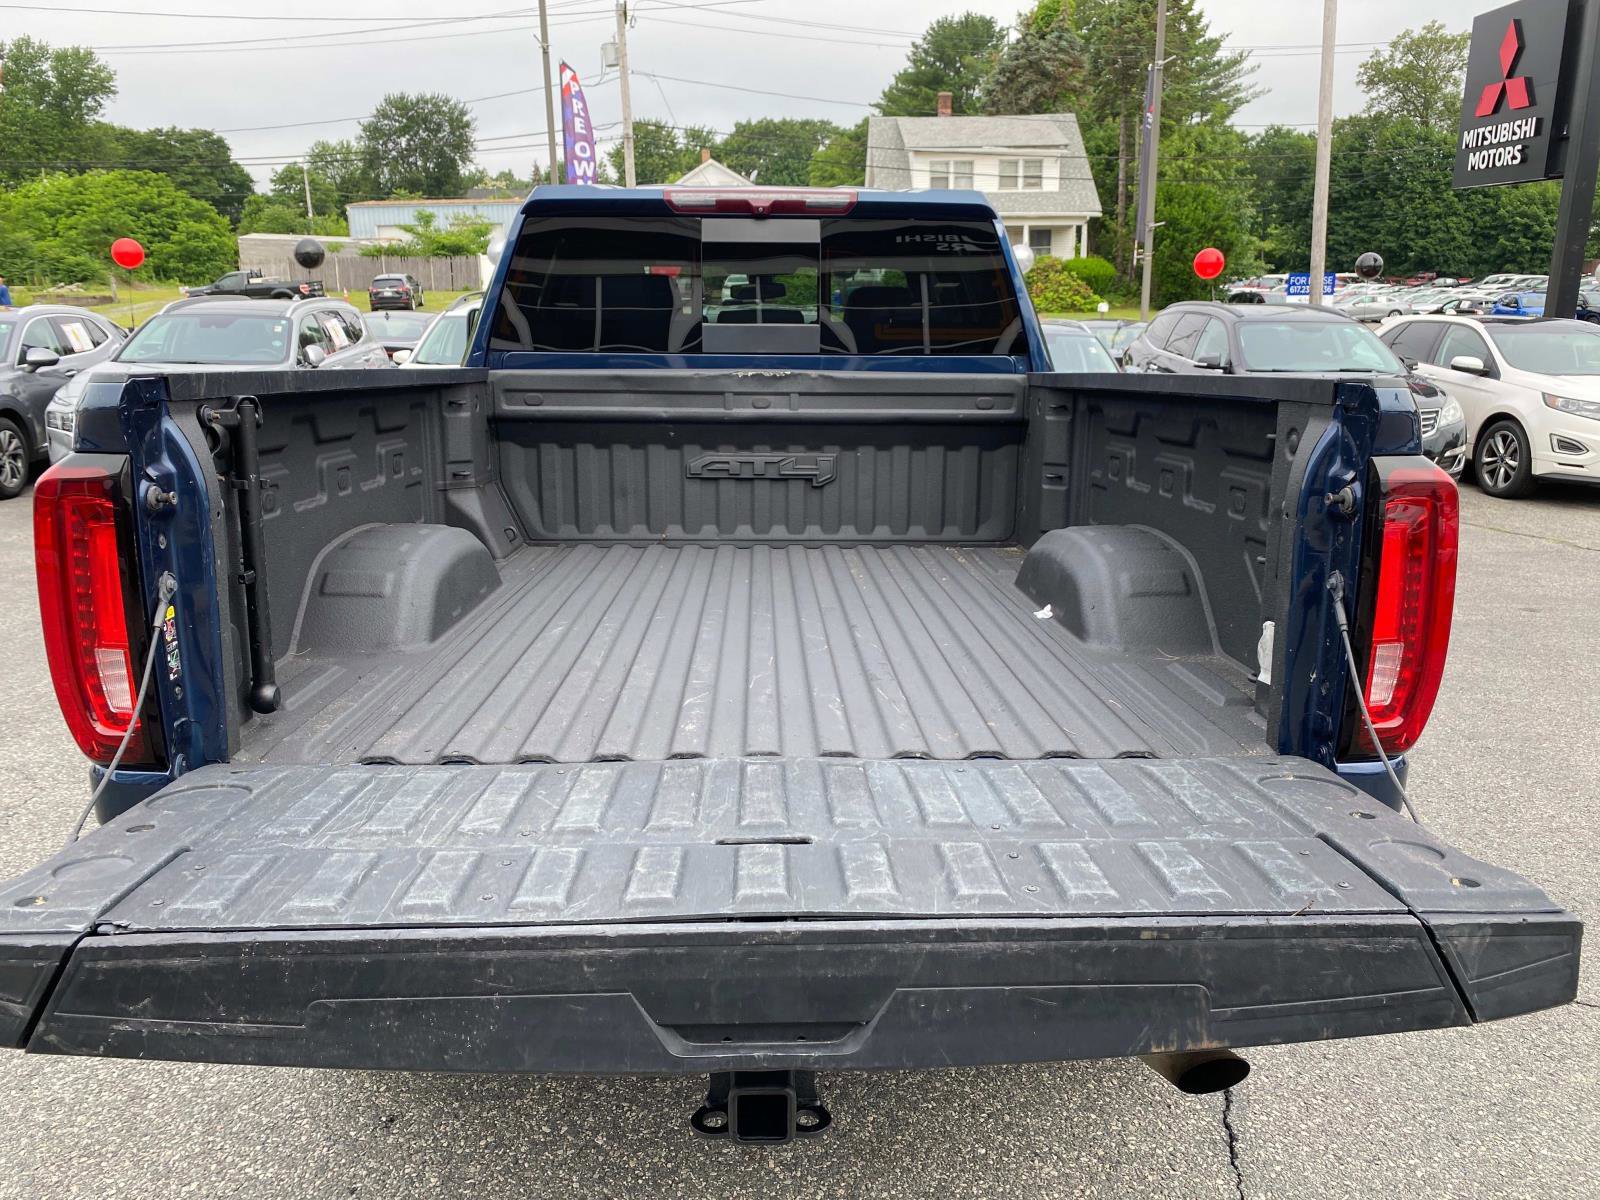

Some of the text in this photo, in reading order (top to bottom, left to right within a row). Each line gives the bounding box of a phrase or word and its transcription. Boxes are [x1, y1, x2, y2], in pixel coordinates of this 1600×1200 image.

[1461, 117, 1536, 149] MITSUBISHI
[1467, 144, 1522, 171] MOTORS
[1290, 276, 1307, 285] FOR
